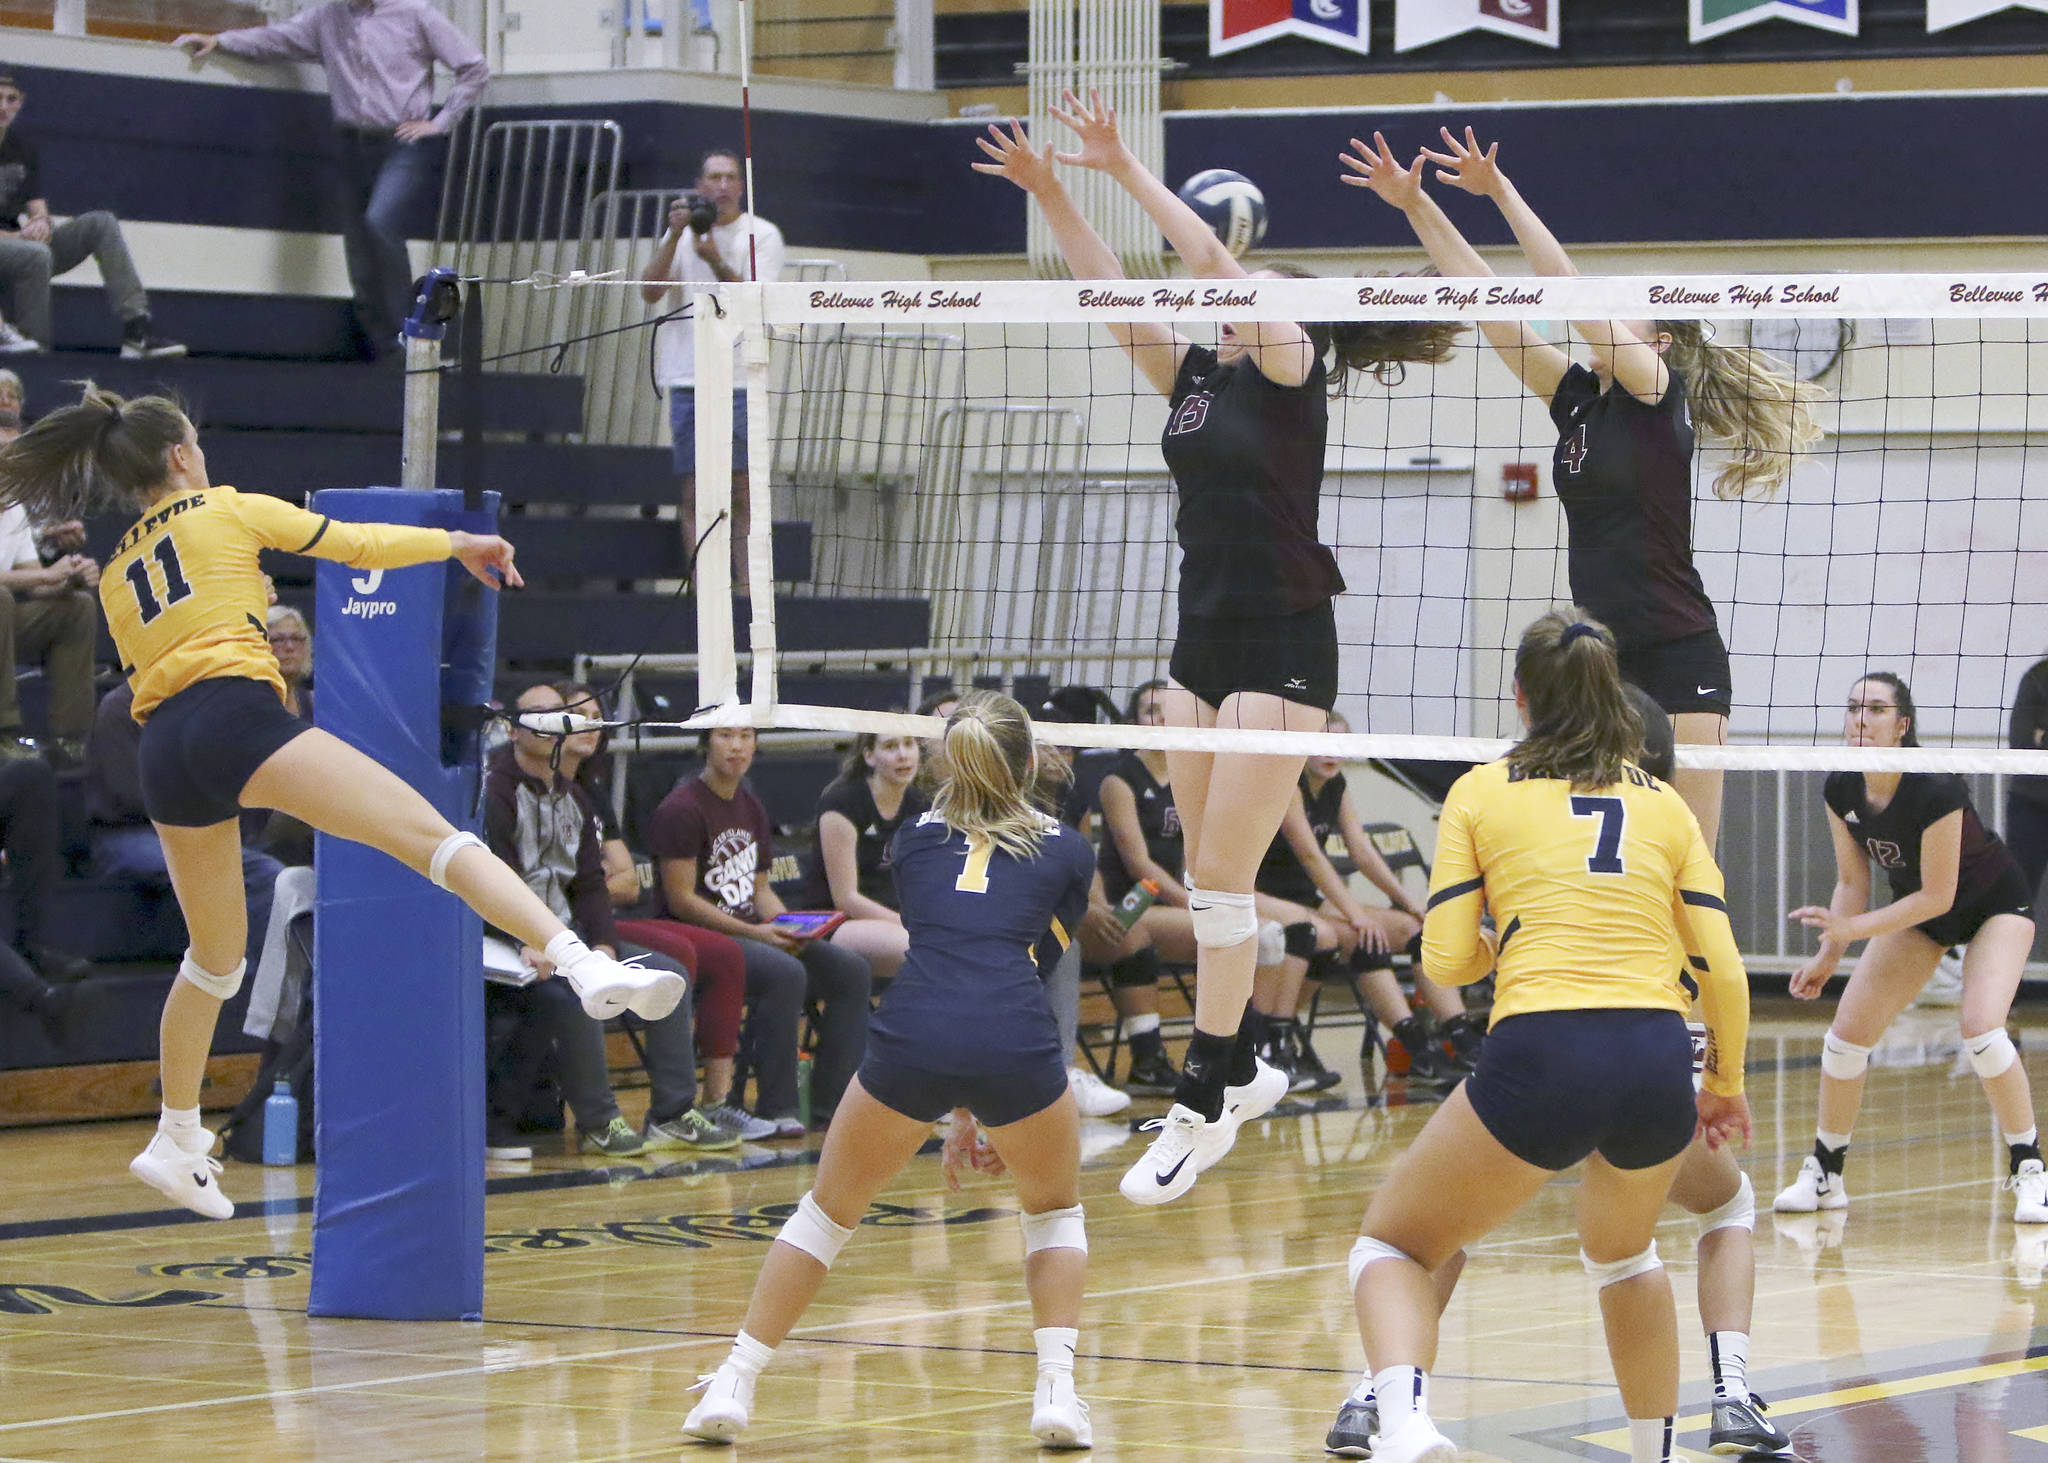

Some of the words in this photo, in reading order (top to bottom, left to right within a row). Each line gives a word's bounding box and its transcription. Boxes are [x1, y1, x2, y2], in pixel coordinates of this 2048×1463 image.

[809, 290, 875, 309] Bellevue
[880, 289, 922, 314] High
[927, 289, 982, 309] School
[1077, 288, 1146, 308] Bellevue
[1152, 288, 1196, 313] High
[1200, 288, 1257, 308] School
[1357, 286, 1428, 306] Bellevue
[1434, 286, 1479, 311] High
[1485, 286, 1544, 306] School
[1648, 285, 1721, 305] Bellevue
[1727, 284, 1774, 310] High
[1779, 284, 1840, 304] School
[1948, 283, 2024, 303] Bellevue
[1560, 423, 1588, 474] 4
[125, 531, 193, 627] 11
[341, 597, 397, 619] Jaypro
[1569, 793, 1627, 877] 7
[953, 833, 990, 894] 1
[1867, 837, 1906, 869] 12
